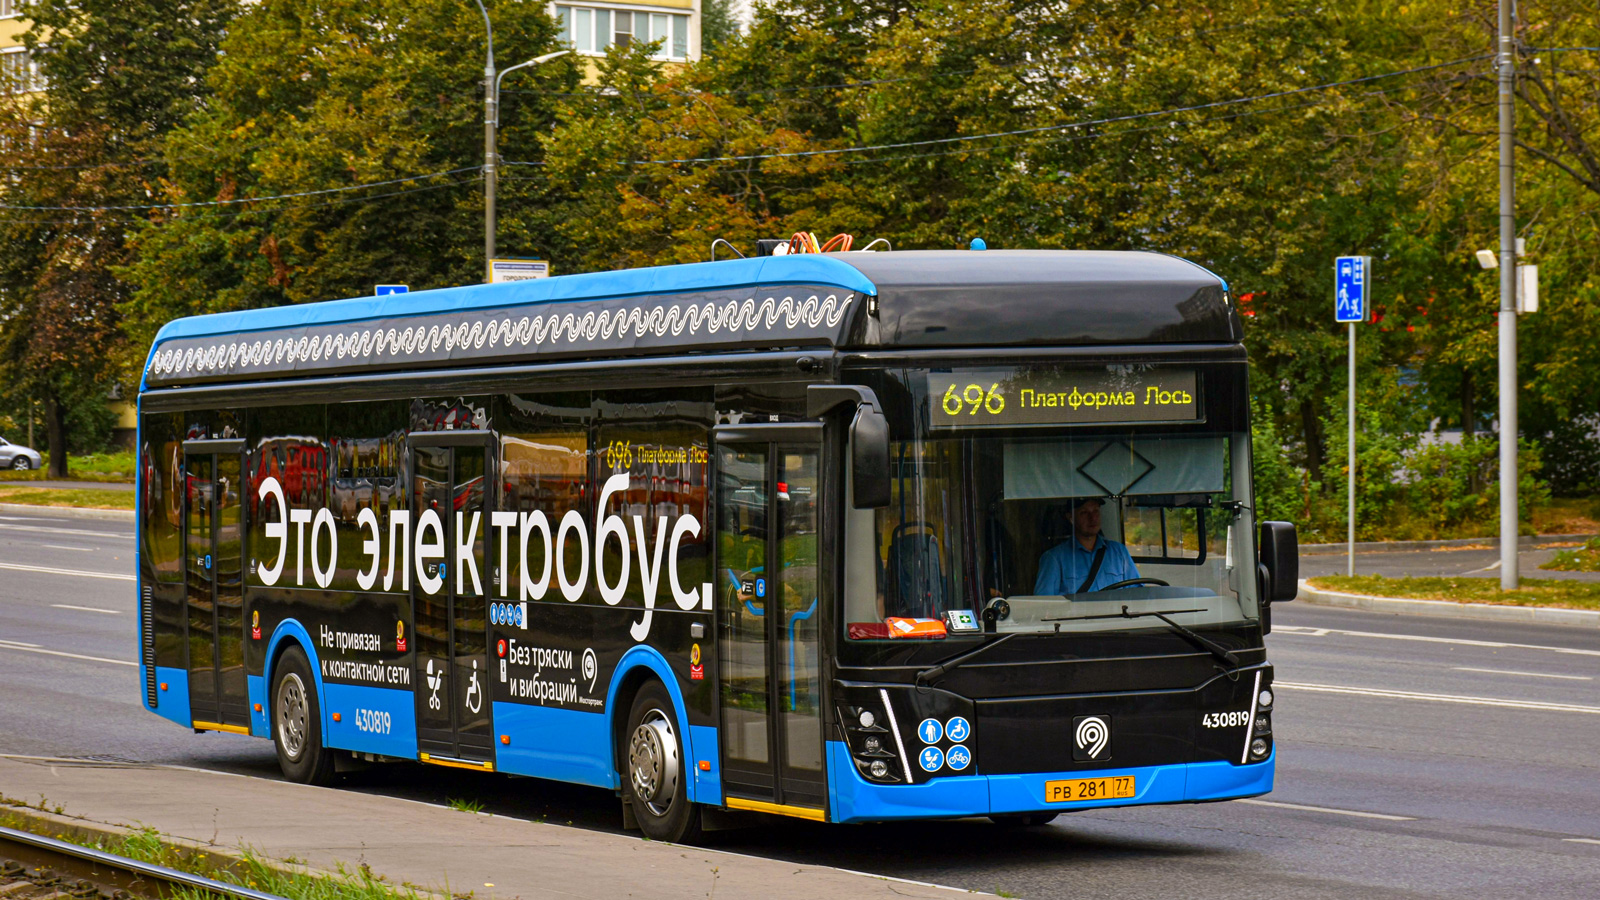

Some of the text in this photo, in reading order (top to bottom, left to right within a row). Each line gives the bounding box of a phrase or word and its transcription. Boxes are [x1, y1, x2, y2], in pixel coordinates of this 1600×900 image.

[942, 383, 1192, 416] 696 Платформа Лось
[606, 440, 708, 469] 696 Платформа Лос
[257, 476, 338, 588] Это
[320, 624, 381, 655] Не привязан
[509, 638, 573, 673] Без тряски
[321, 660, 410, 685] к контактной сети
[510, 672, 577, 706] и вибраций
[355, 708, 392, 735] 430819
[1202, 710, 1250, 729] 430819
[1078, 780, 1106, 798] 281
[1115, 777, 1130, 791] 77
